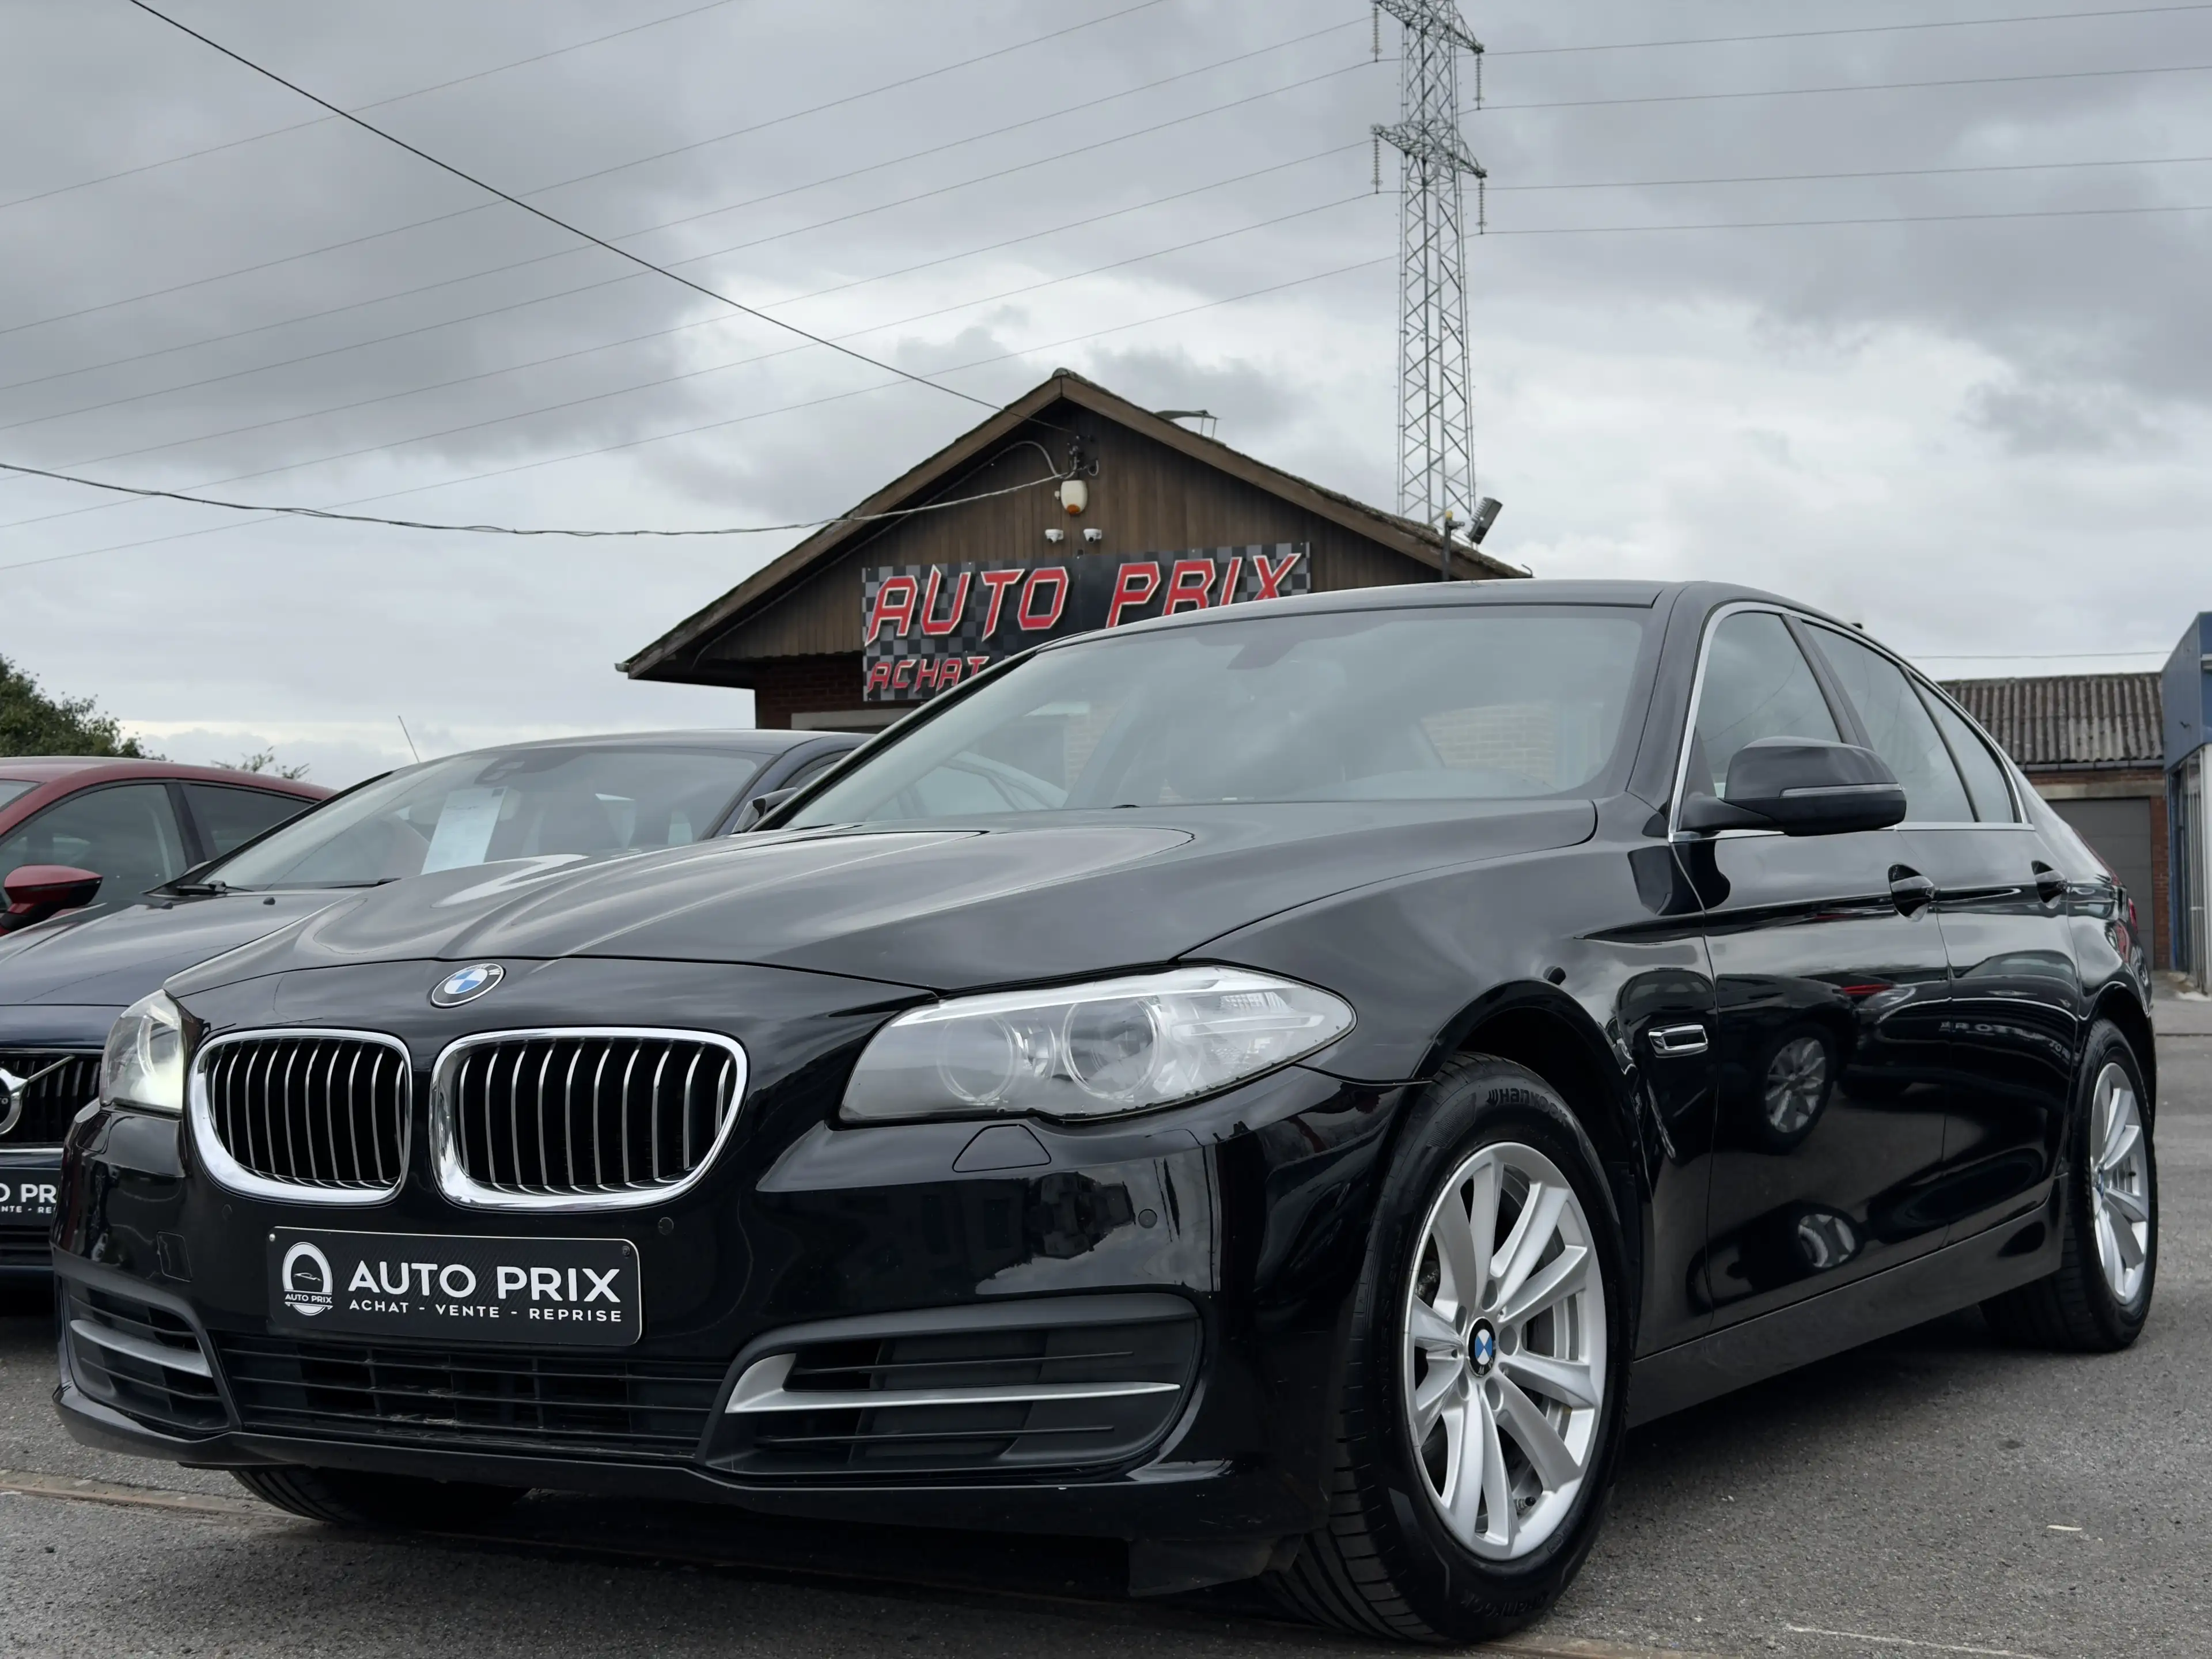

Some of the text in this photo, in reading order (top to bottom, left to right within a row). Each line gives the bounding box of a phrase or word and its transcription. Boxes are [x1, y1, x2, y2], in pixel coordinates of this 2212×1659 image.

[865, 552, 1302, 647] AUTO PRIX
[866, 656, 990, 693] ACHAT
[37, 1206, 56, 1214] RE
[347, 1259, 622, 1304] AUTO PRIX
[285, 1293, 332, 1304] AUTO PRIX
[349, 1299, 409, 1313] ACHAT
[435, 1304, 500, 1319] VENTE
[528, 1308, 622, 1323] REPRISE
